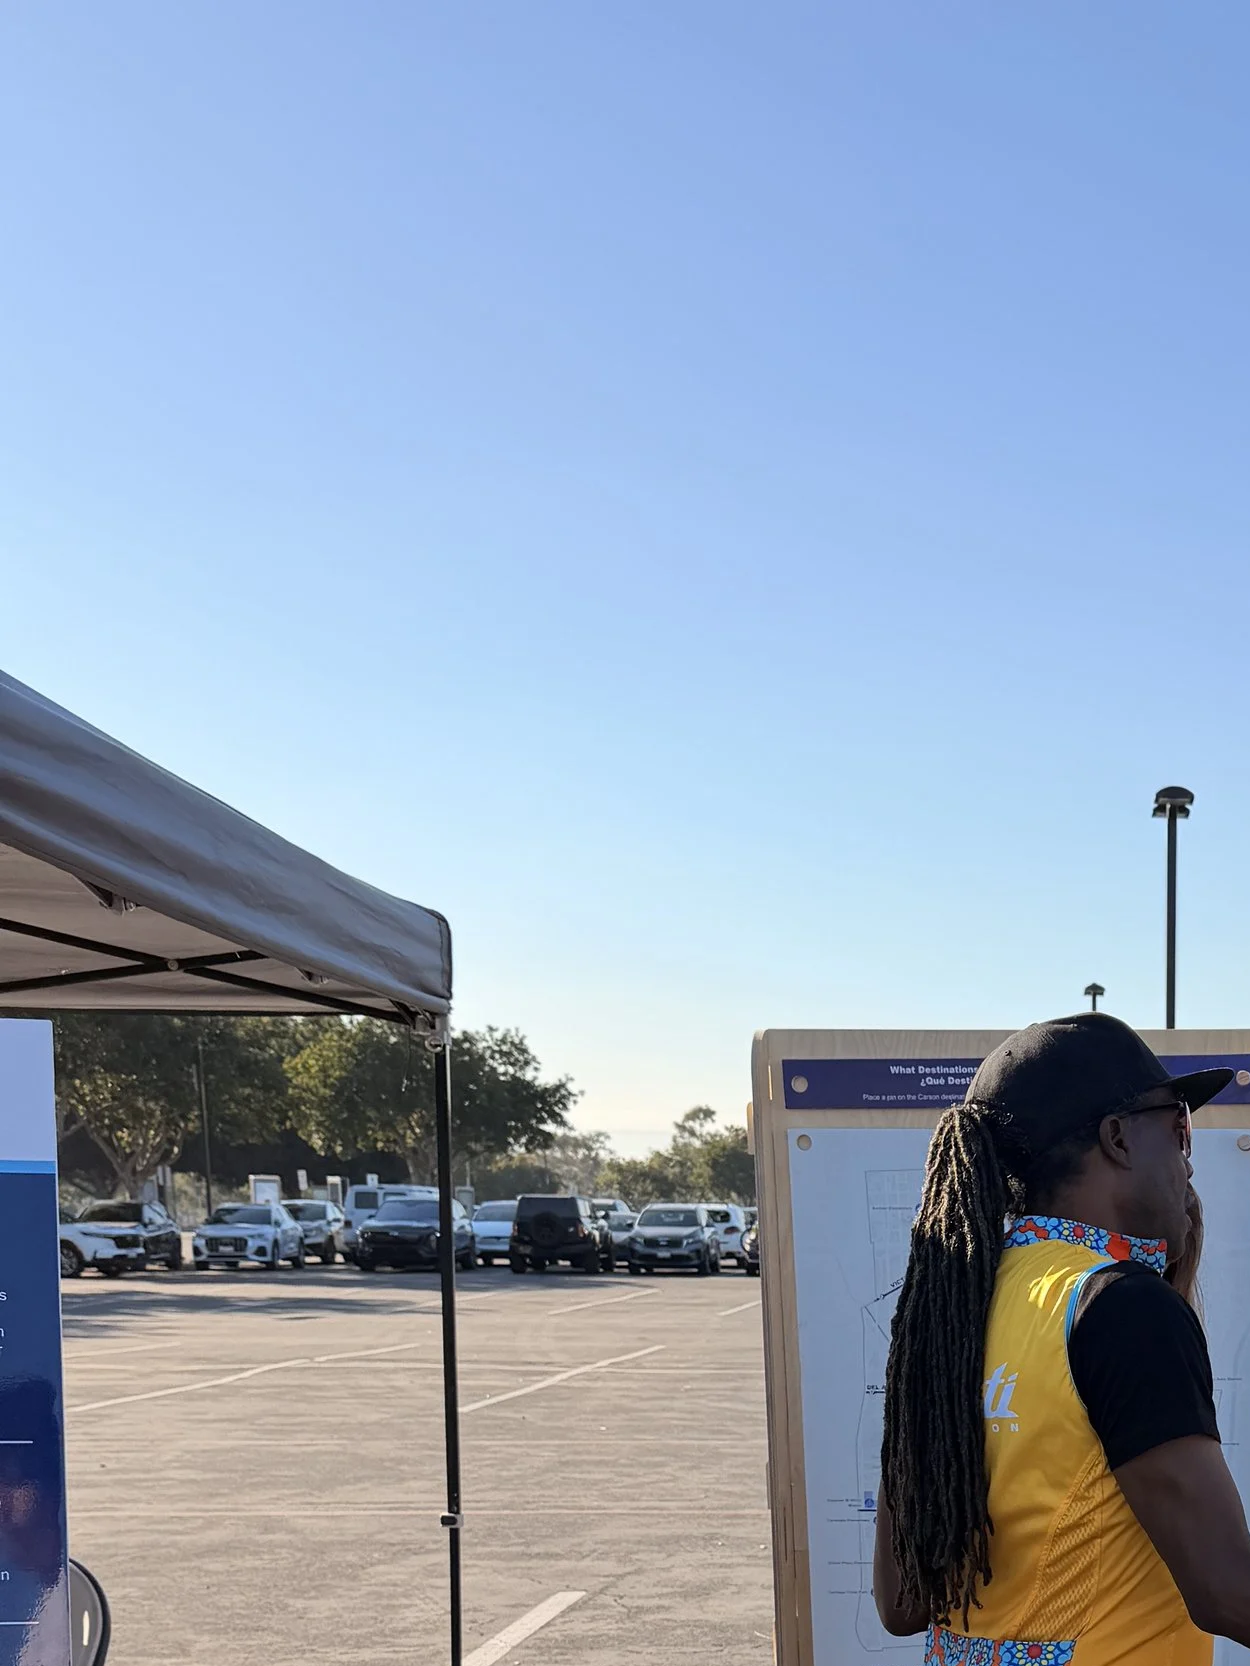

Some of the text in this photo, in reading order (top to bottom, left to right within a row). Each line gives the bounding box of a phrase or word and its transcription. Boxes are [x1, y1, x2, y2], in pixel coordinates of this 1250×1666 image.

[889, 1065, 978, 1074] What Destinations
[920, 1076, 972, 1087] ¿Qué Desti
[862, 1093, 880, 1101] Place
[887, 1094, 897, 1102] pin
[940, 1093, 965, 1102] destina
[889, 1276, 905, 1289] VICT
[984, 1361, 1020, 1419] ti
[991, 1422, 1019, 1433] ON
